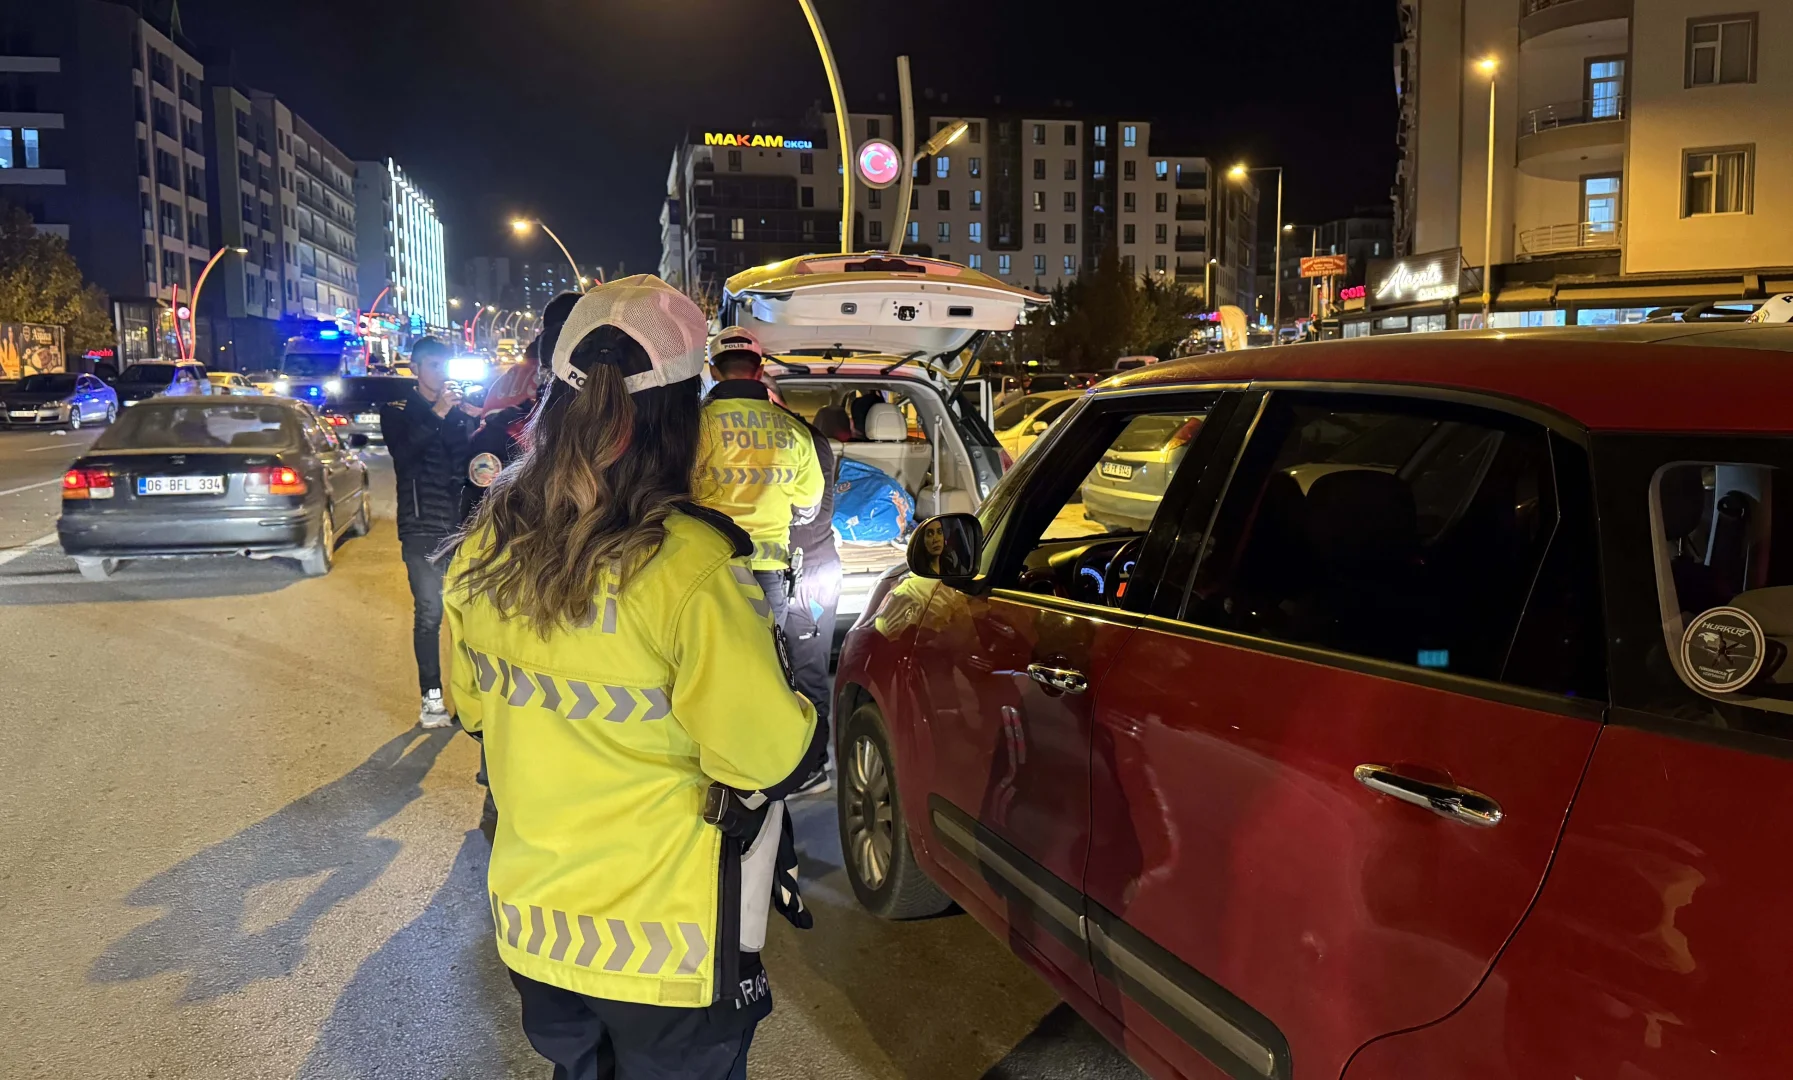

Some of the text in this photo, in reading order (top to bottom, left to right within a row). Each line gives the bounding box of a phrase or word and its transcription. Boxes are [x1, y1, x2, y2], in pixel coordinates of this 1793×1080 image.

[704, 132, 783, 148] MAKAM
[147, 478, 220, 492] 06 BFL 334
